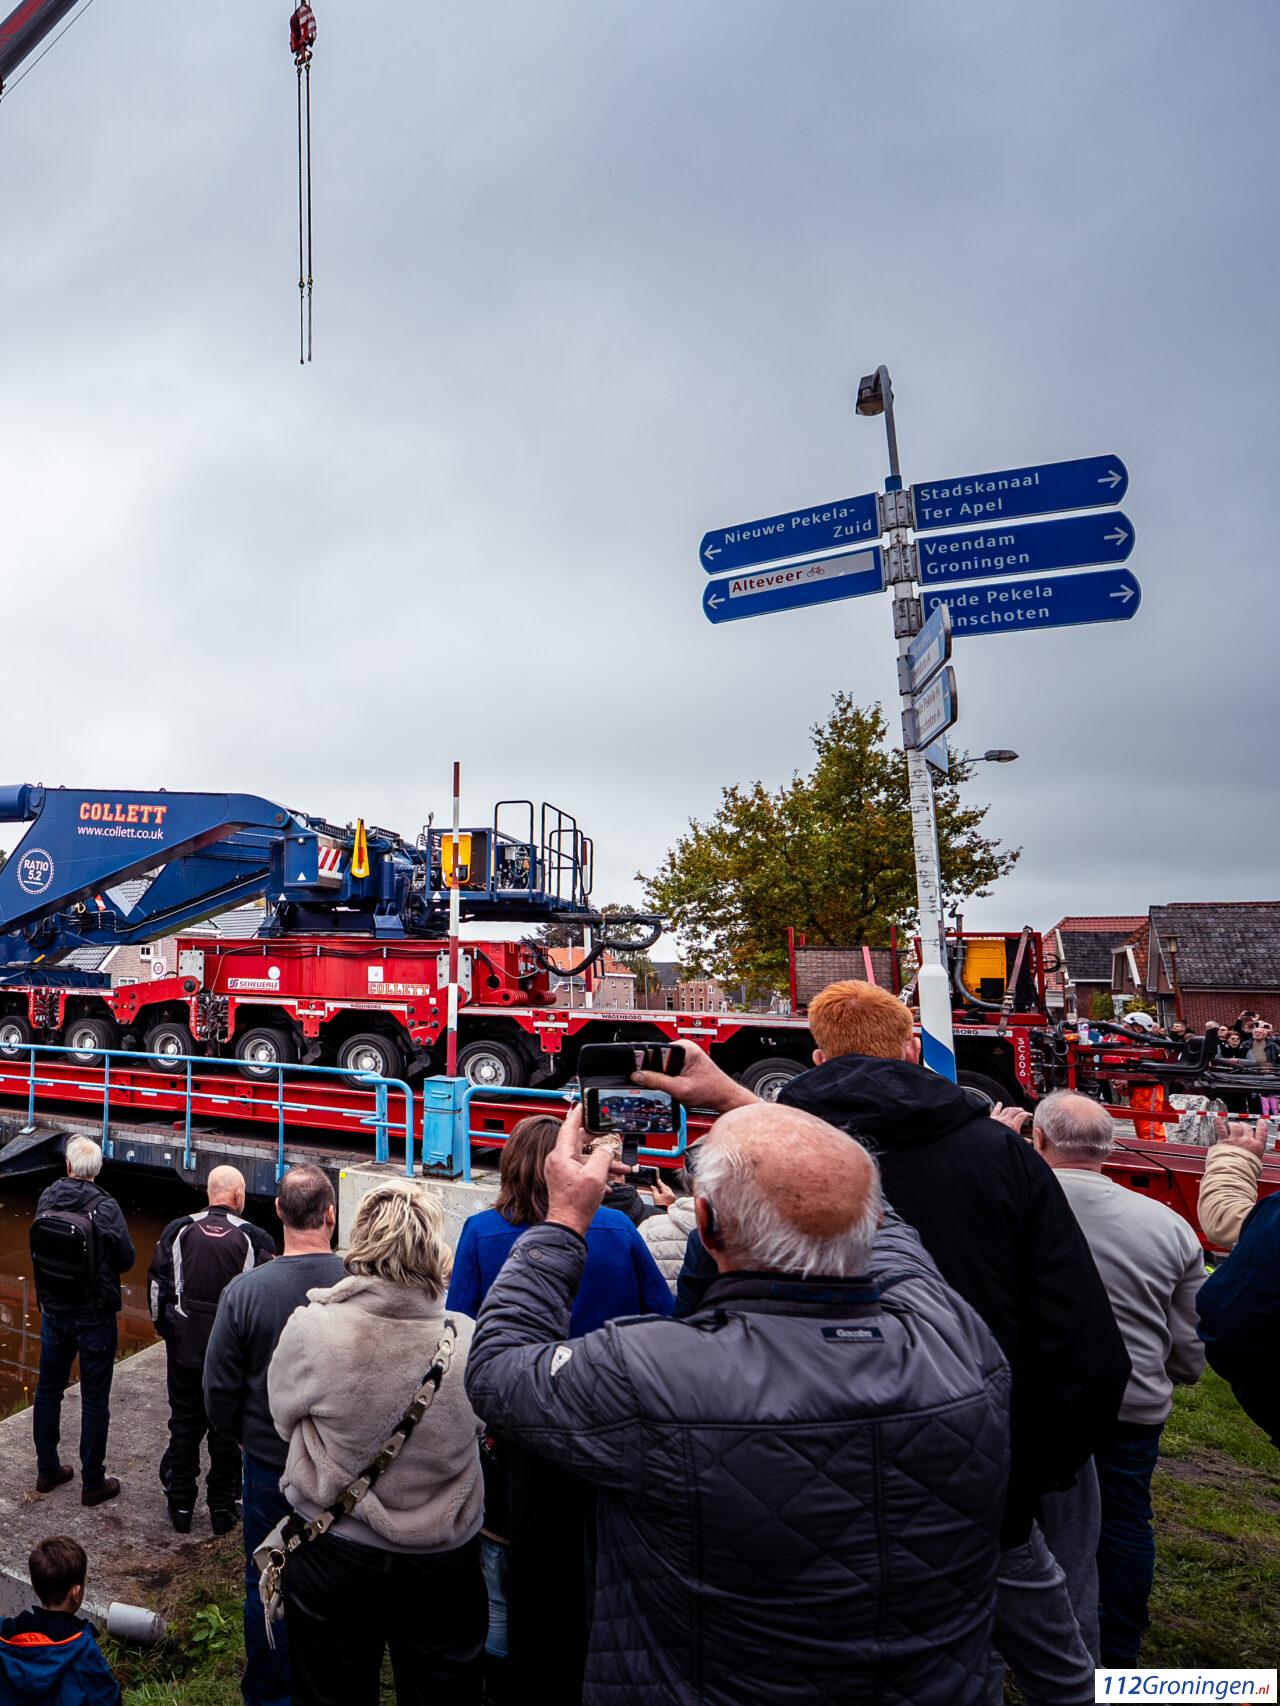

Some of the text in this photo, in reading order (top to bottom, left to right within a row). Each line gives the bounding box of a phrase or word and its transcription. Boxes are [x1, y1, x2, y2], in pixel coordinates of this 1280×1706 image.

[920, 472, 1040, 501] Stadskanaal
[922, 498, 1003, 520] Ter Apel
[724, 506, 855, 545] Nieuwe Pekela-
[833, 519, 872, 539] Zuid
[925, 532, 1015, 555] Veendam
[926, 552, 1030, 578] Groningen
[732, 569, 802, 594] Alteveer
[929, 585, 1053, 611] Oude Pekela
[951, 605, 1050, 627] inschoten
[79, 802, 168, 824] COLLETT
[77, 825, 164, 840] www.collett.co.uk
[24, 859, 49, 872] RATIO
[28, 870, 43, 881] 5.2
[239, 980, 278, 989] SCHEUERLE
[369, 984, 430, 995] COLLETT
[1018, 1038, 1026, 1077] SC606
